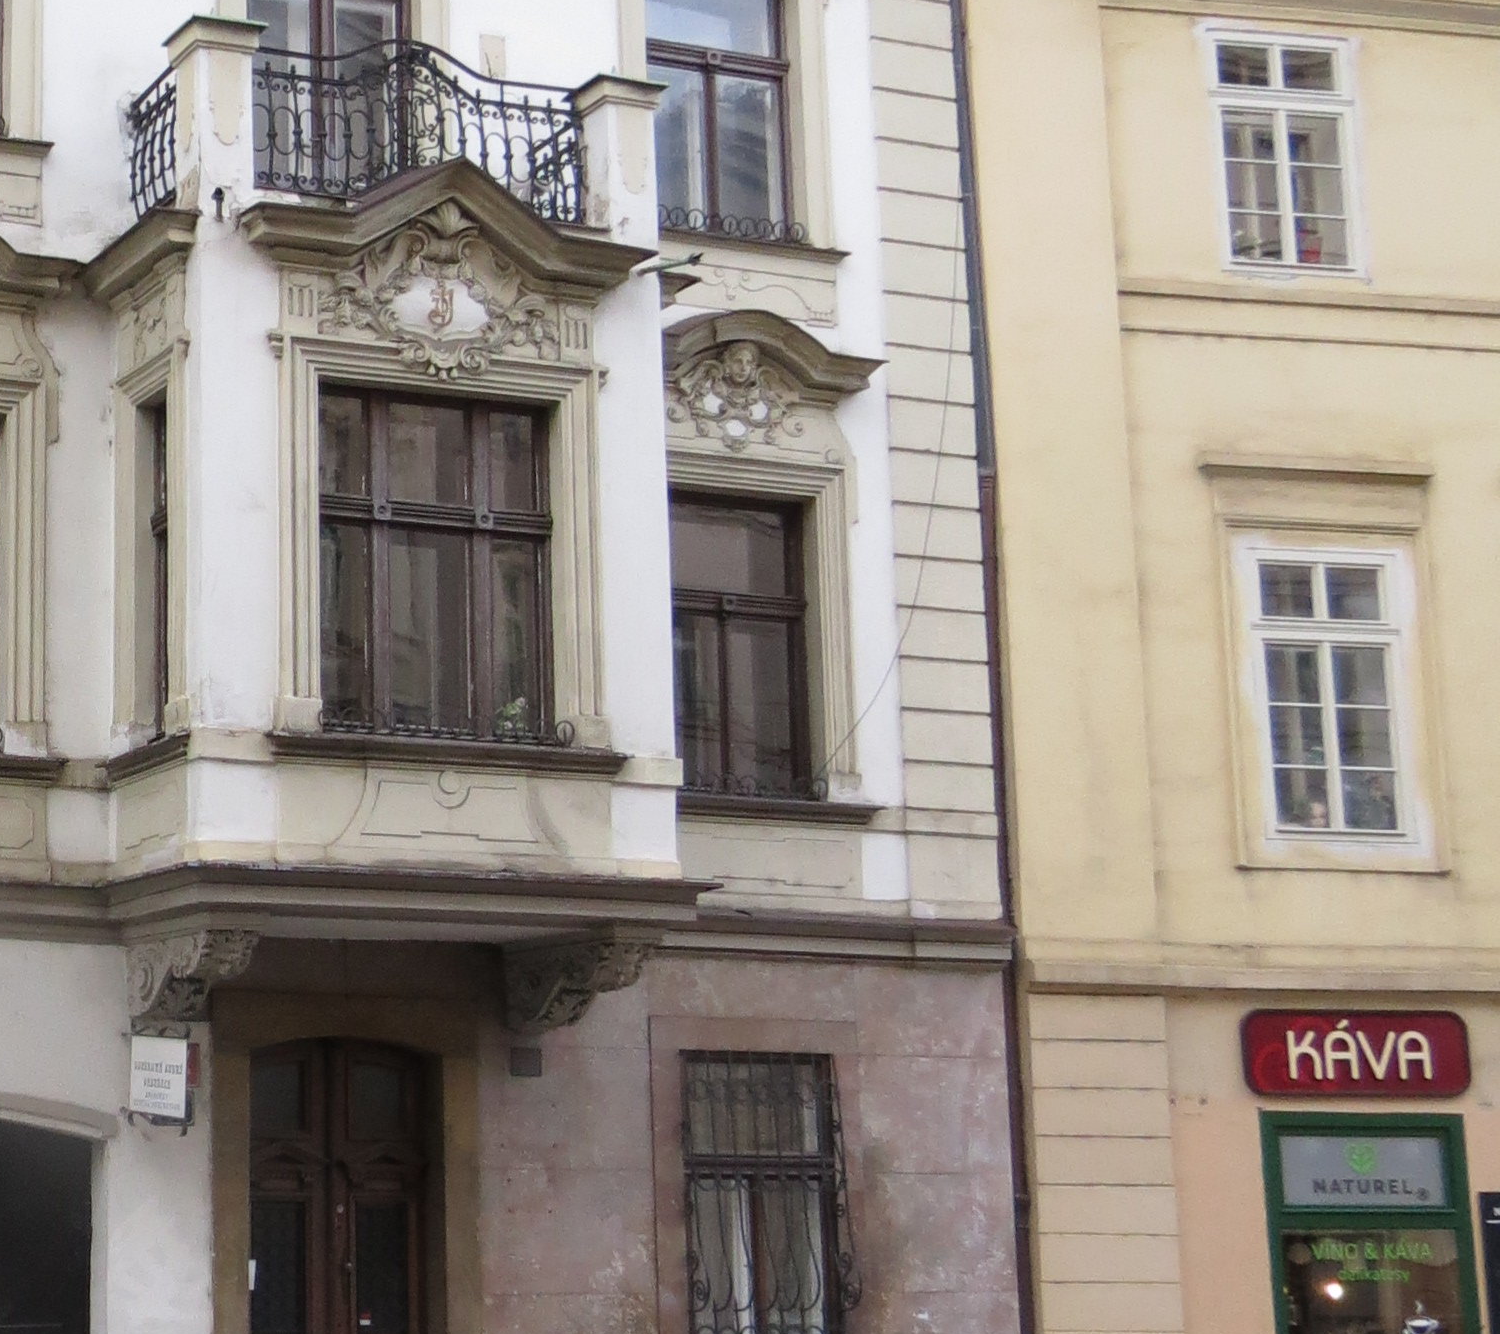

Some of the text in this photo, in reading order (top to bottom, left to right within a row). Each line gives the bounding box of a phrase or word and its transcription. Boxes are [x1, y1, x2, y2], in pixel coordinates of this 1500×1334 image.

[1285, 1019, 1433, 1081] KÁVA
[1312, 1179, 1413, 1196] NATUREL
[1364, 1242, 1379, 1260] &
[1383, 1237, 1432, 1260] KÁVA
